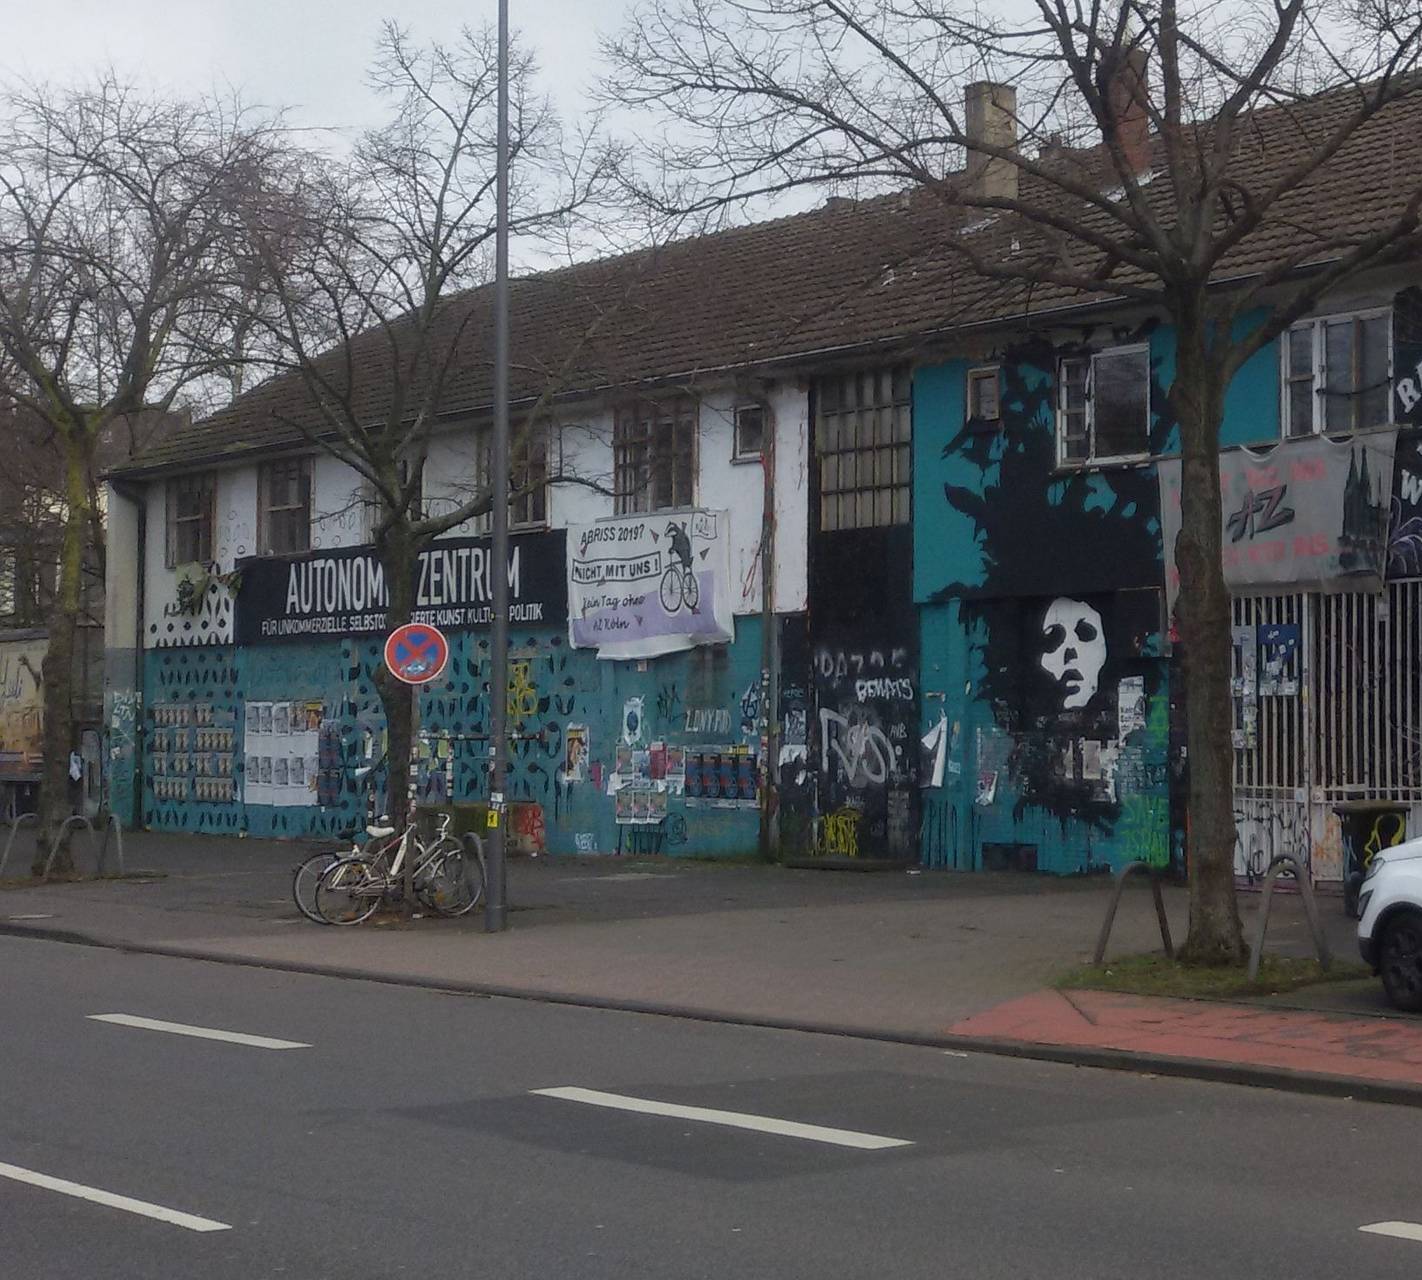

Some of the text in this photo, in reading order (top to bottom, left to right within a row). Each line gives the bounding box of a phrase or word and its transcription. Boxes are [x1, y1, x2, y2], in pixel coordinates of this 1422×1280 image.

[580, 524, 645, 545] ABRISS 2019?
[574, 565, 601, 580] NICHT
[605, 565, 625, 578] MIT
[629, 560, 650, 577] UNS
[285, 556, 390, 614] AUTONOM
[436, 608, 465, 626] KUNST
[508, 602, 543, 622] POLITIK
